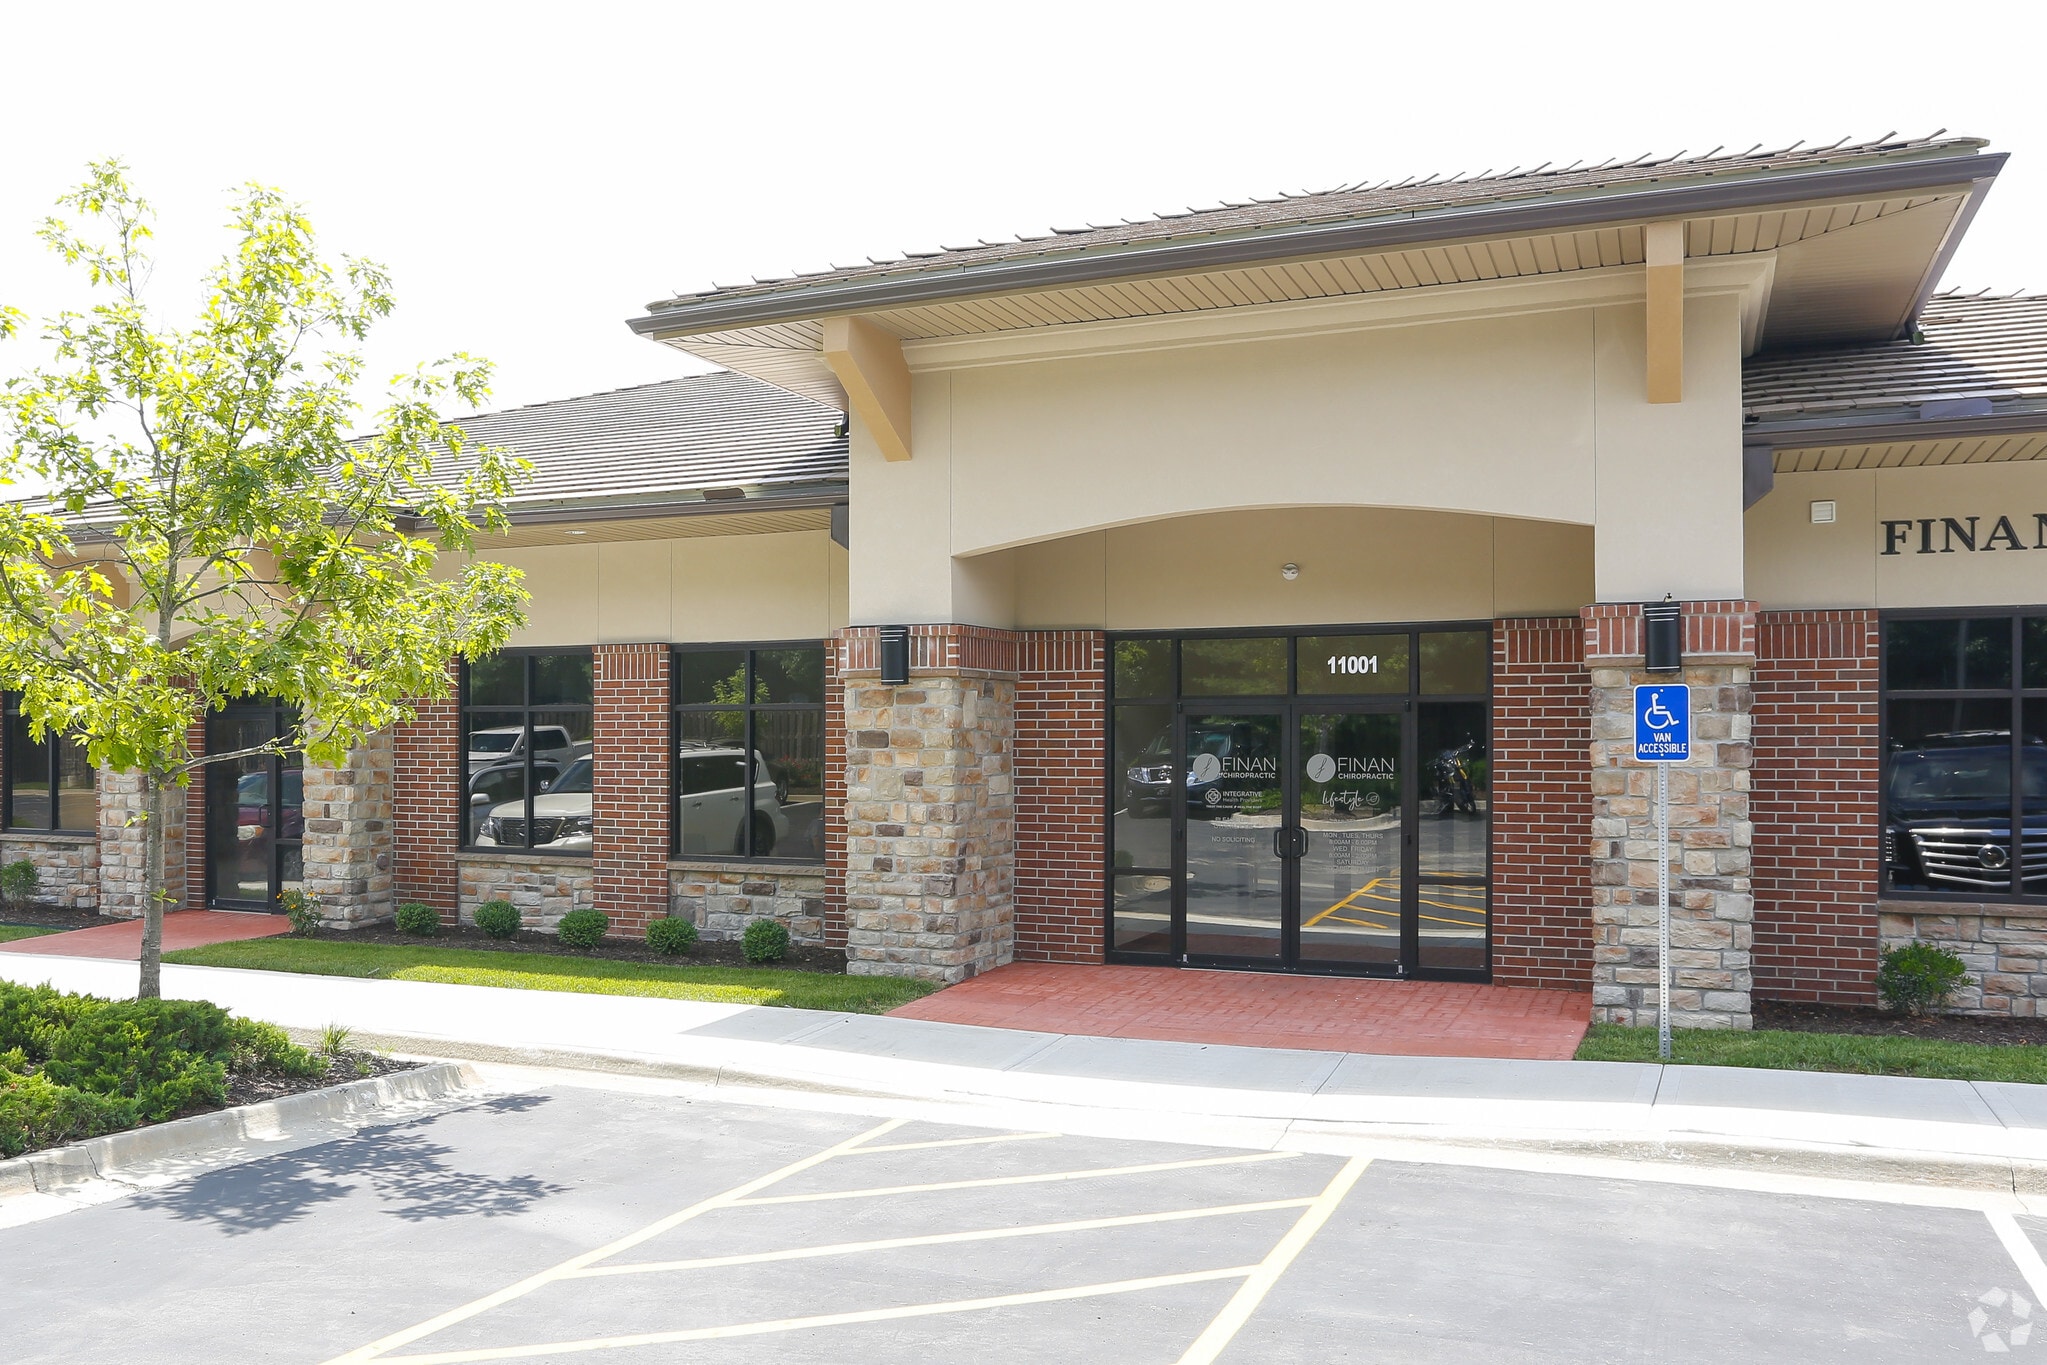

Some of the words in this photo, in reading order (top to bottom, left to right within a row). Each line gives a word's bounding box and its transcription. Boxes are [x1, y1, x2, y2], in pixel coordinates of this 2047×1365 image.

[1327, 655, 1378, 674] 11001
[1653, 732, 1672, 743] VAN
[1638, 743, 1687, 753] ACCESSIBLE
[1222, 756, 1276, 772] FINAN
[1338, 756, 1394, 772] FINAN
[1222, 836, 1256, 844] SOLICITING
